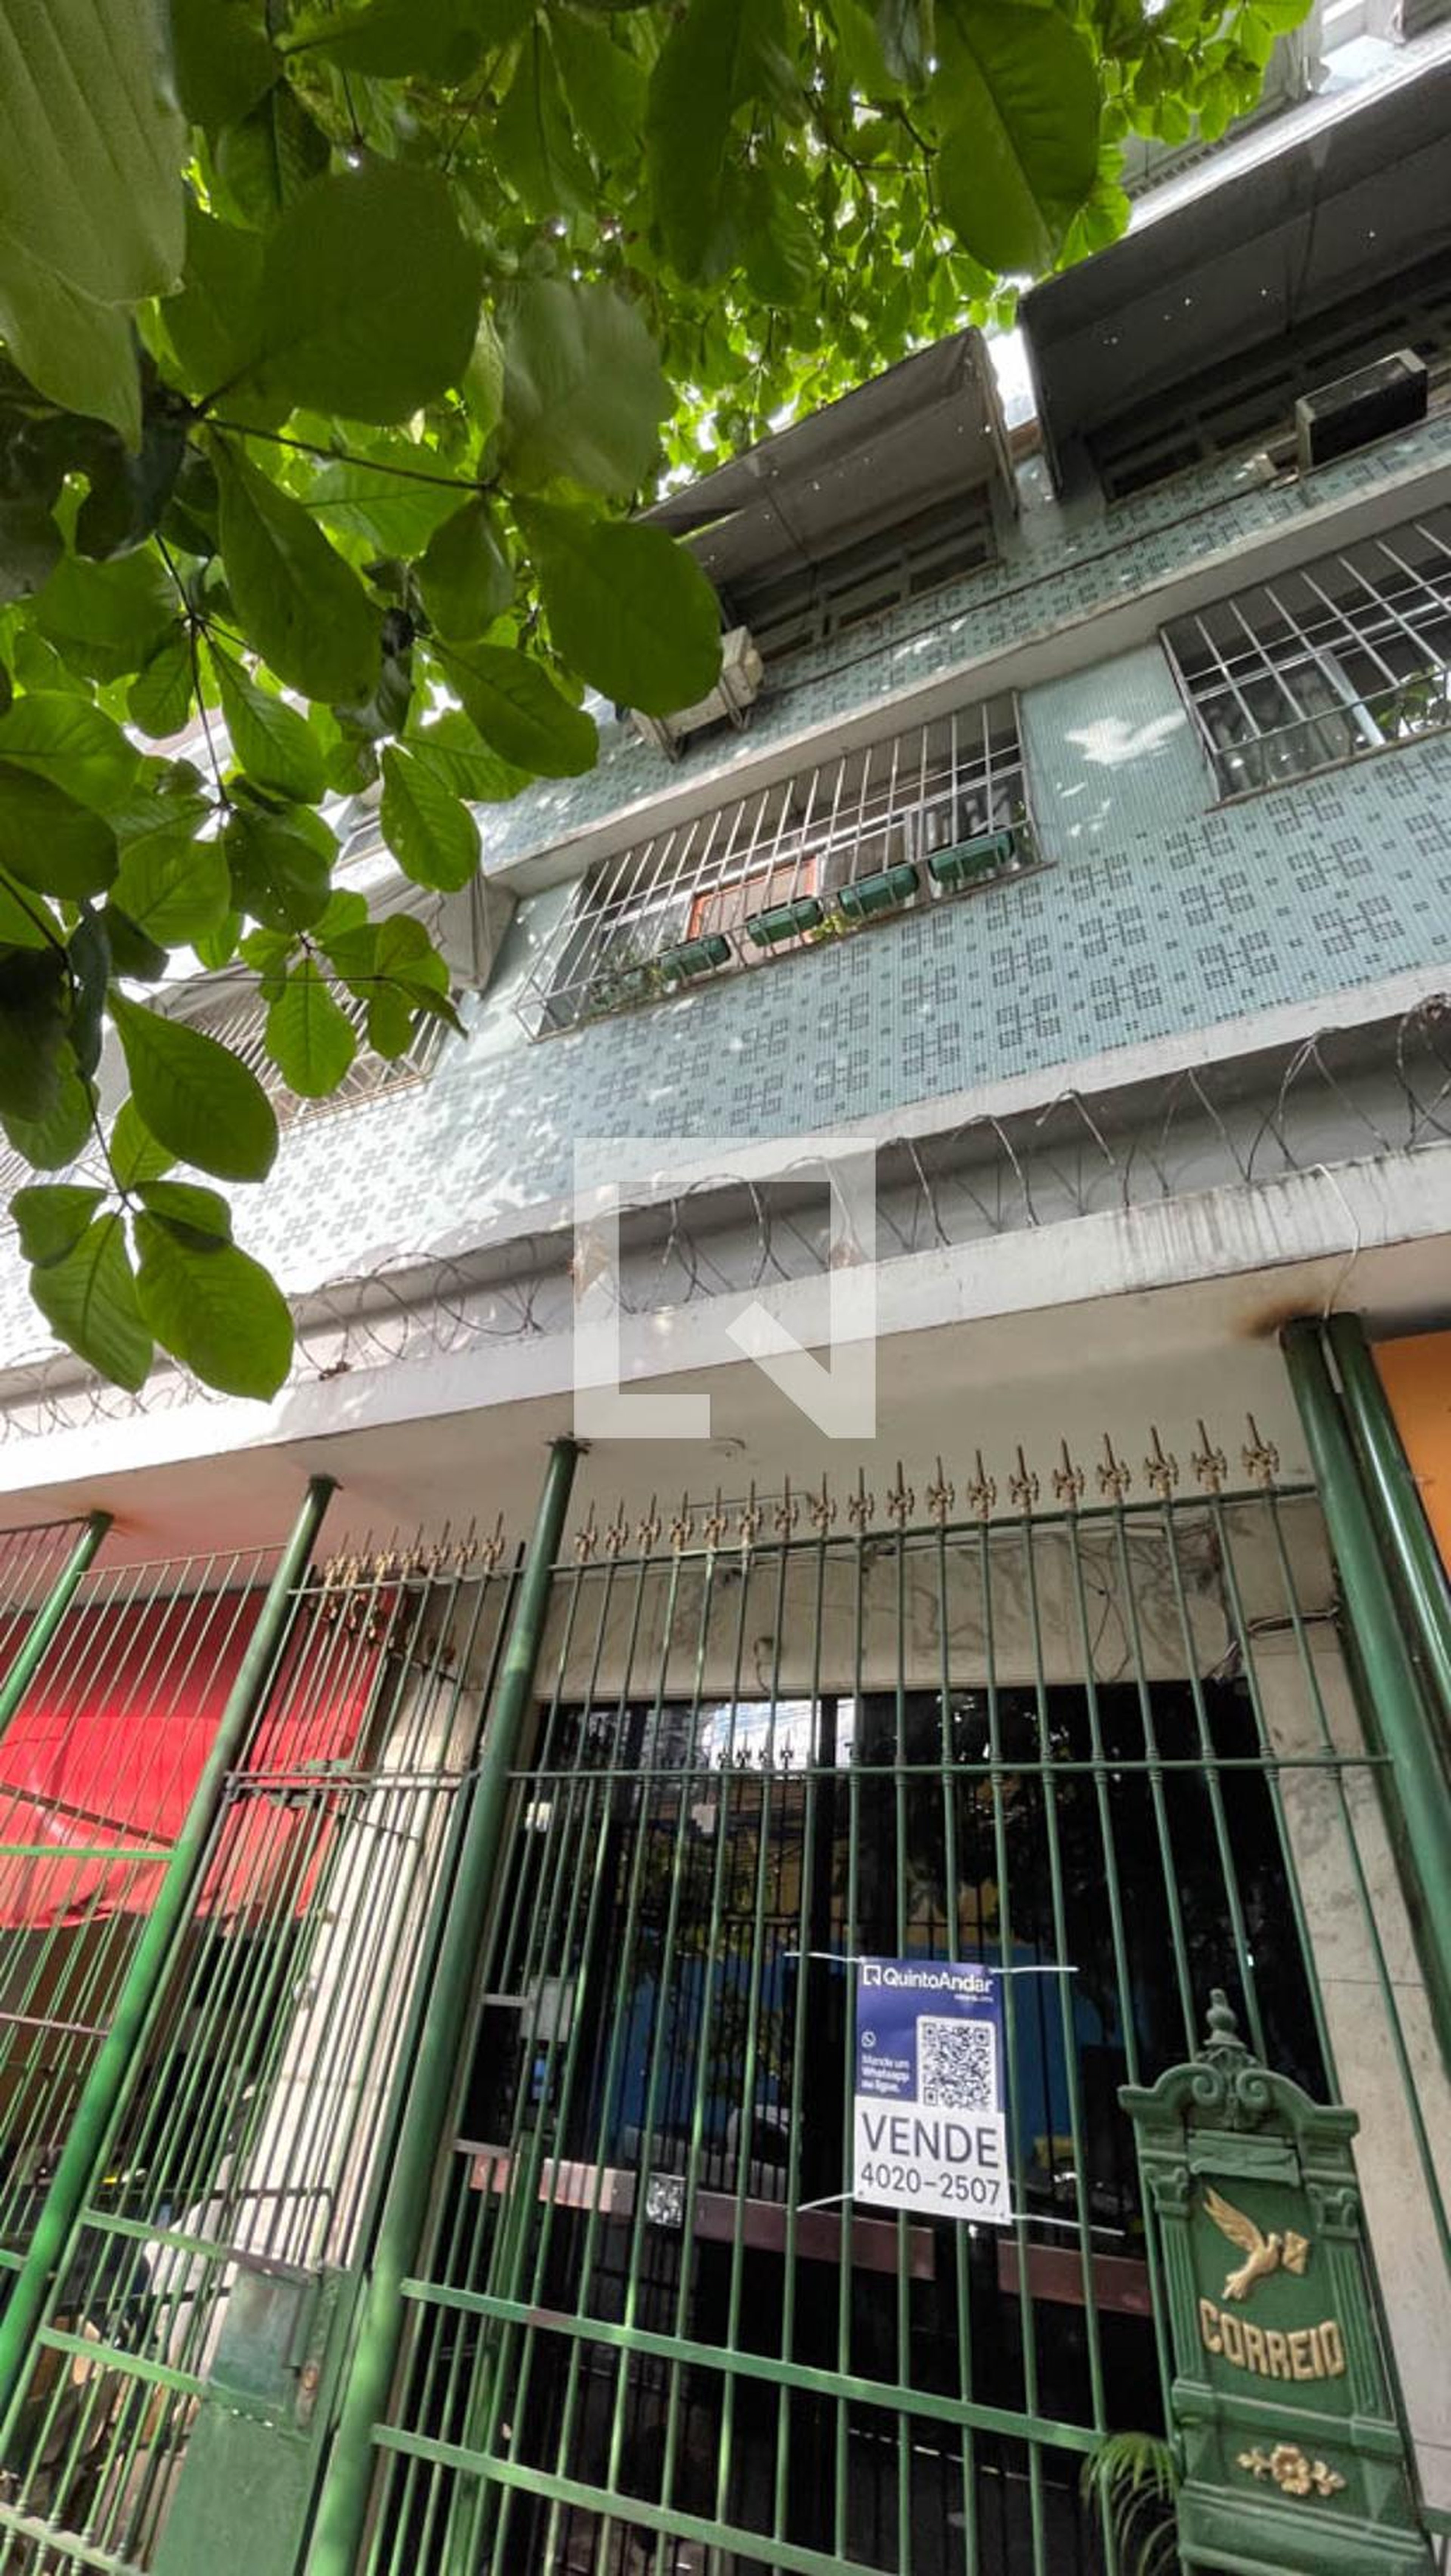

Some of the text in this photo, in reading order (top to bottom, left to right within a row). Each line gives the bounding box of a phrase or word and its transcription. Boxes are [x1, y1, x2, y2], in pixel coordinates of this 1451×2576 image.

[883, 1967, 993, 1993] QuintoAndar
[862, 2112, 998, 2168] VENDE
[861, 2162, 1000, 2205] 4020-2507
[1200, 2298, 1344, 2380] CORREIO
